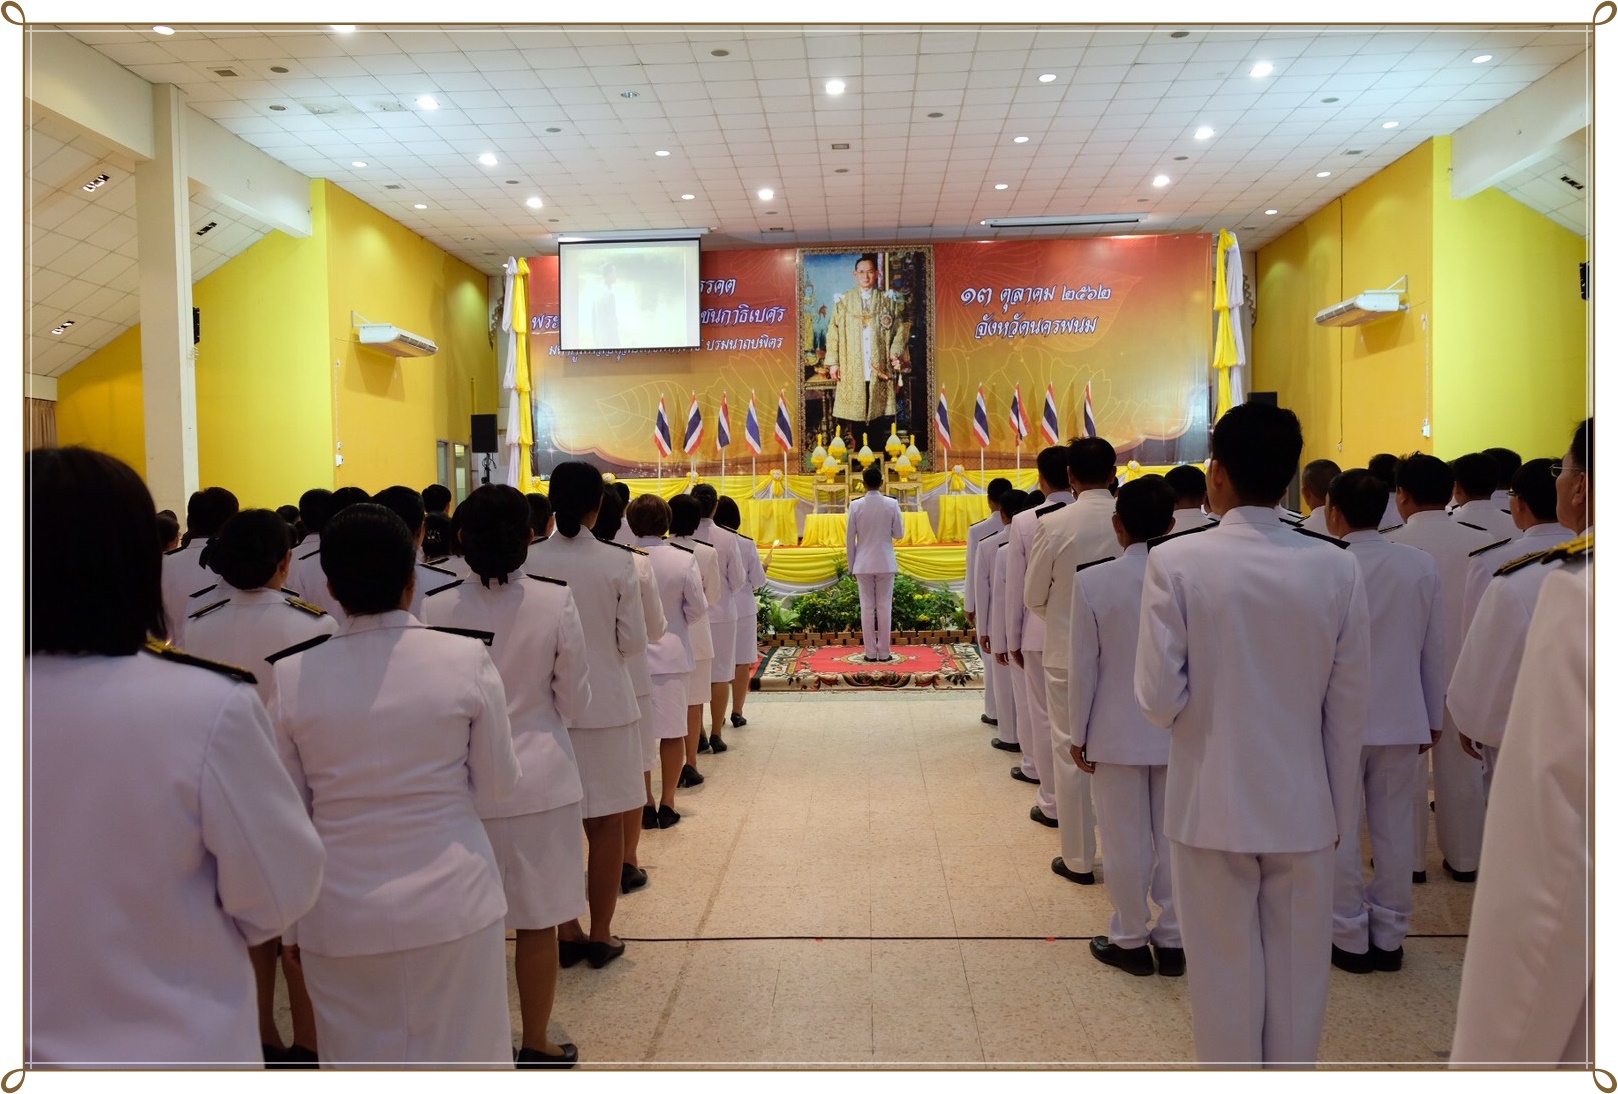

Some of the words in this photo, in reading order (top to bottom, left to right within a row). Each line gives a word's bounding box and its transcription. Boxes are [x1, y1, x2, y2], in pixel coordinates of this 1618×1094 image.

[960, 286, 992, 306] ๑๓
[1001, 284, 1056, 314] ตุลาคม
[1061, 284, 1111, 301] ๒๕๖๒
[975, 312, 1098, 338] จังหวัดนครพนม
